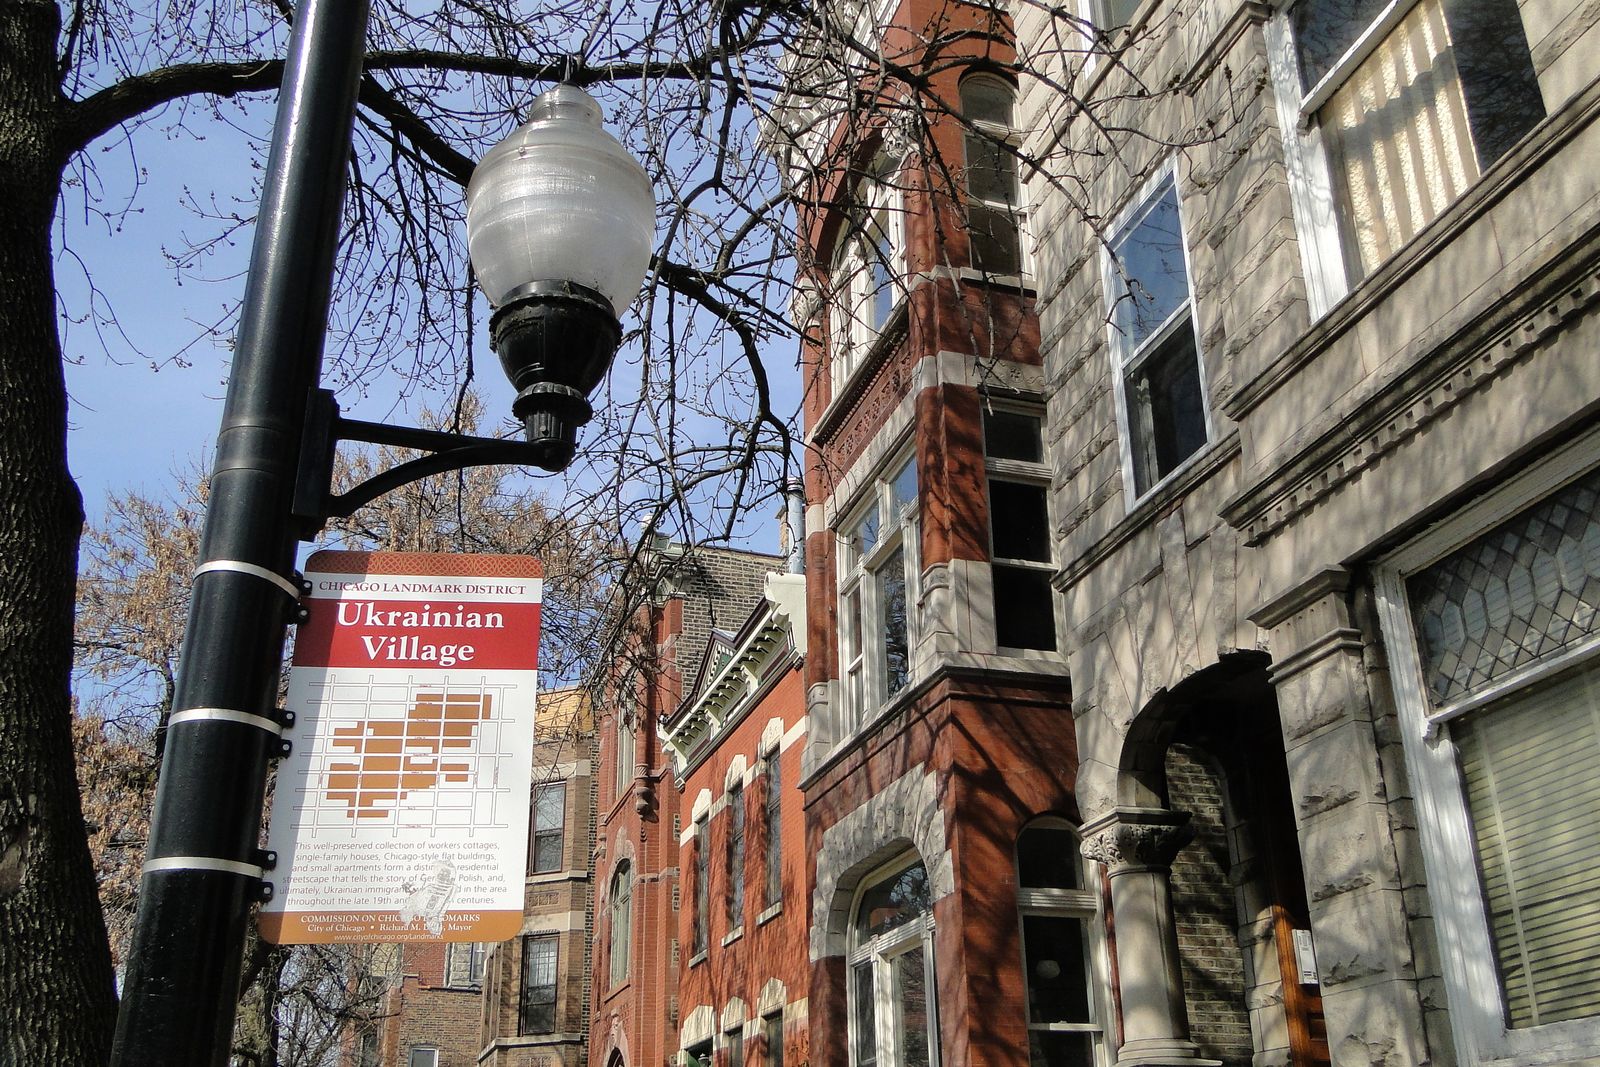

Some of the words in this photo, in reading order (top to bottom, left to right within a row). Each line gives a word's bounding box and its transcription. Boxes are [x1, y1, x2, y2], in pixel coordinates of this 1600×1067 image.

[319, 581, 380, 592] CHICAGO
[383, 583, 463, 594] LANDMARK
[465, 584, 527, 595] DISTRICT
[337, 602, 504, 628] Ukrainian
[361, 635, 475, 667] Village
[296, 842, 311, 850] This
[313, 842, 373, 851] well-preserved
[375, 841, 415, 850] collection
[417, 841, 426, 850] of
[428, 841, 461, 850] workers
[463, 842, 500, 851] cottages,
[296, 852, 348, 862] single-family
[351, 852, 380, 862] houses,
[384, 852, 439, 862] Chicago-style
[441, 852, 455, 860] flat
[457, 852, 497, 862] buildings,
[292, 864, 308, 873] and
[310, 864, 332, 872] small
[334, 864, 381, 874] apartments
[384, 864, 404, 872] form
[282, 876, 329, 885] streetscape
[332, 875, 348, 883] that
[351, 875, 367, 883] tells
[371, 875, 384, 883] the
[386, 876, 406, 885] story
[408, 874, 417, 882] of
[459, 874, 484, 883] Polish,
[324, 885, 362, 894] Ukrainian
[464, 885, 472, 893] in
[474, 885, 488, 893] the
[288, 897, 335, 907] throughout
[338, 896, 352, 904] the
[354, 896, 369, 904] late
[373, 896, 392, 904] 19th
[301, 915, 360, 923] COMMISSION
[362, 914, 376, 922] ON
[307, 924, 324, 932] City
[335, 924, 365, 932] Chicago
[448, 924, 472, 932] Mayor
